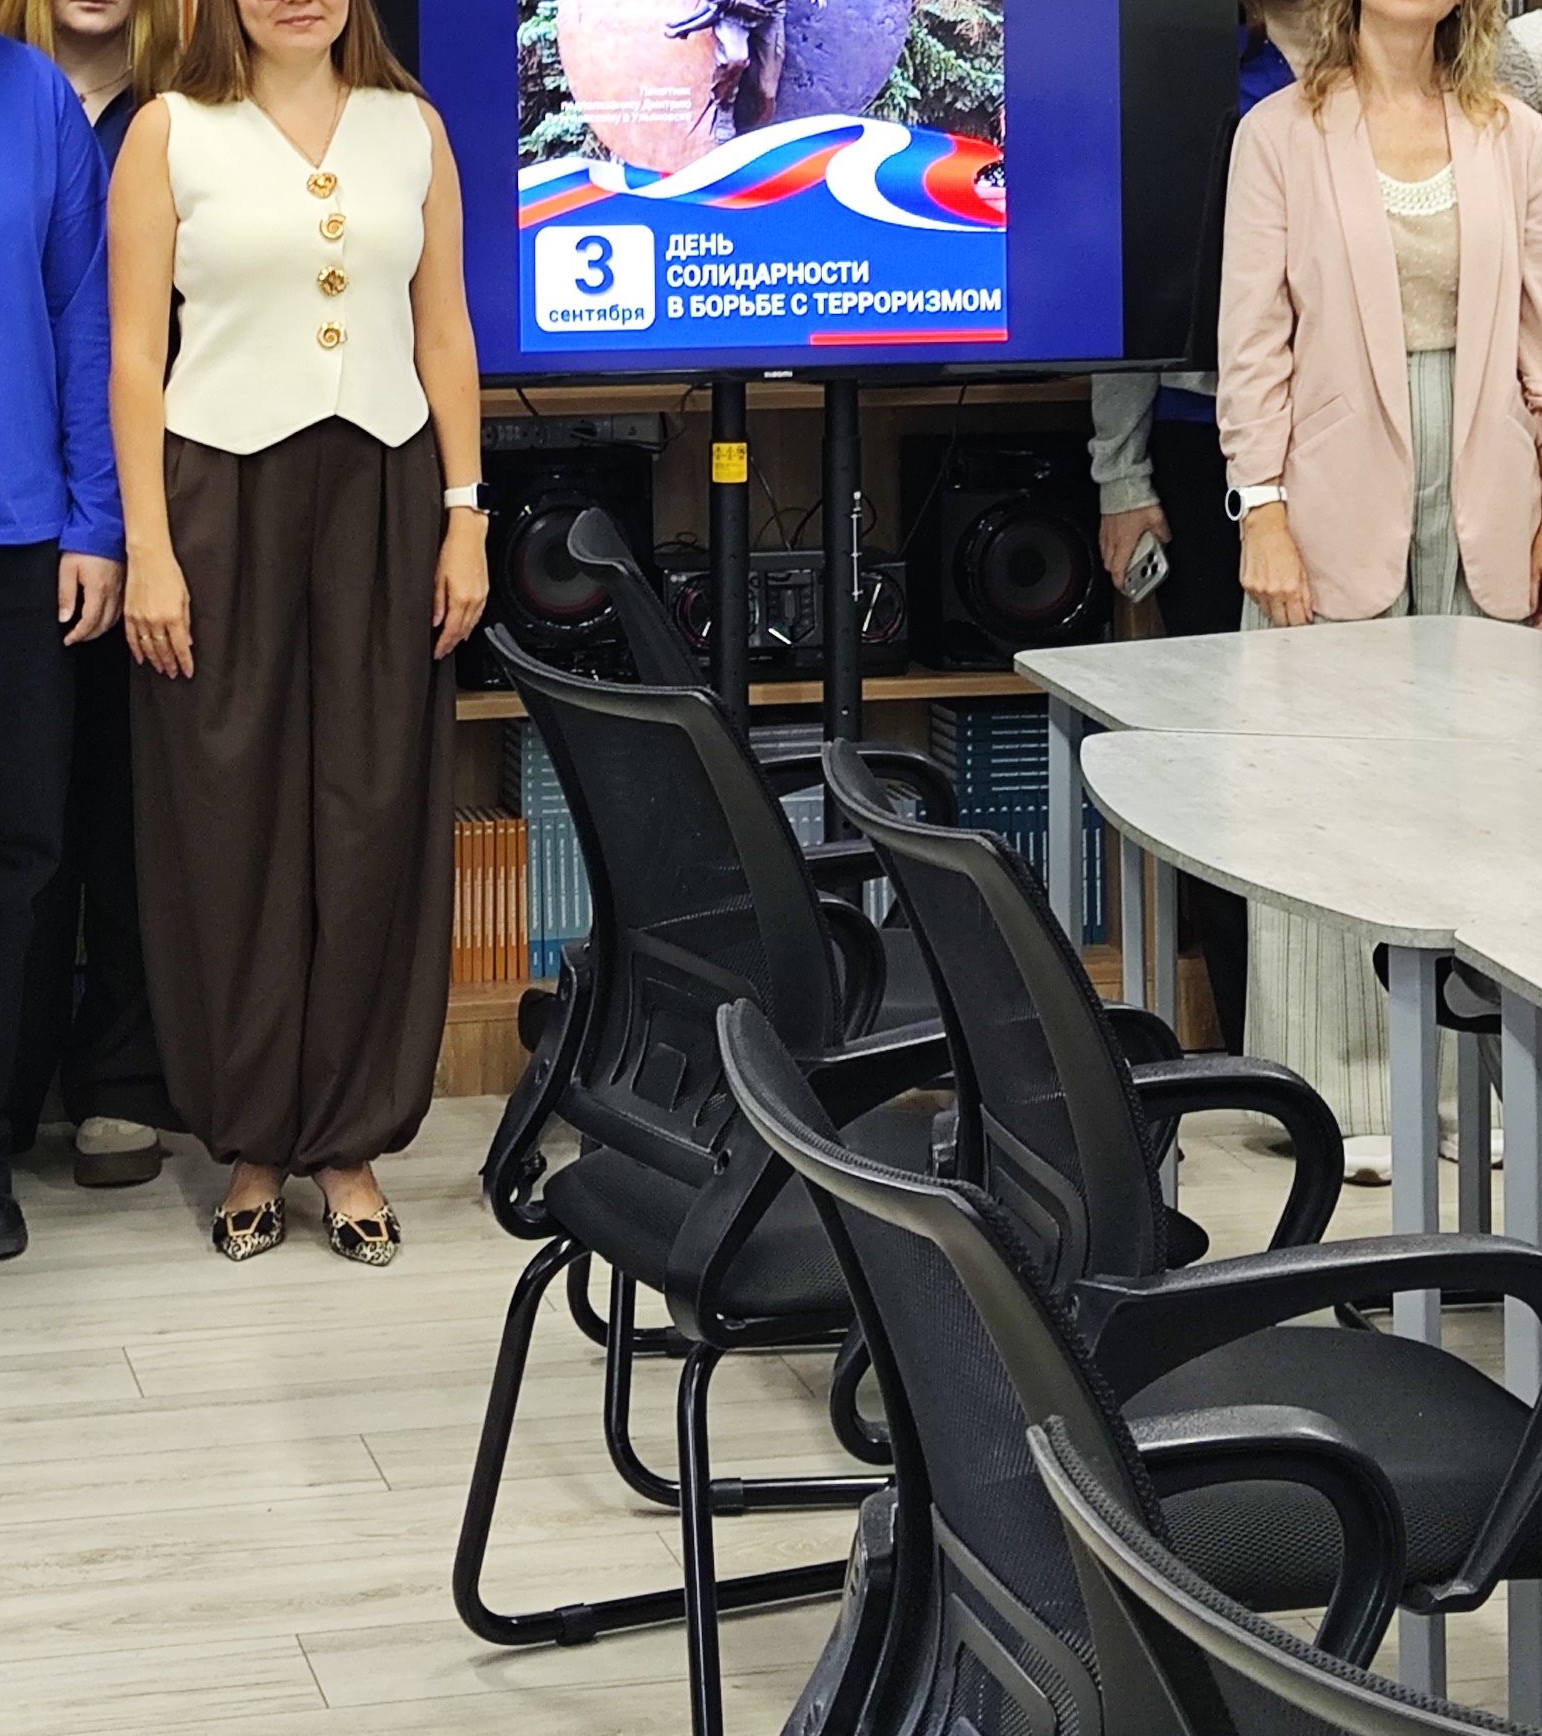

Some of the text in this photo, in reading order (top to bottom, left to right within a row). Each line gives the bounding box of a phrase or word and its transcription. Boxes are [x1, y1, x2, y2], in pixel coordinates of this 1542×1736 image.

[665, 233, 734, 261] ДЕНЬ
[575, 234, 615, 296] 3
[666, 261, 870, 291] СОЛИДАРНОСТИ
[549, 304, 645, 326] сентября
[667, 288, 1002, 318] В БОРЬБЕ С ТЕРРОРИЗМОМ
